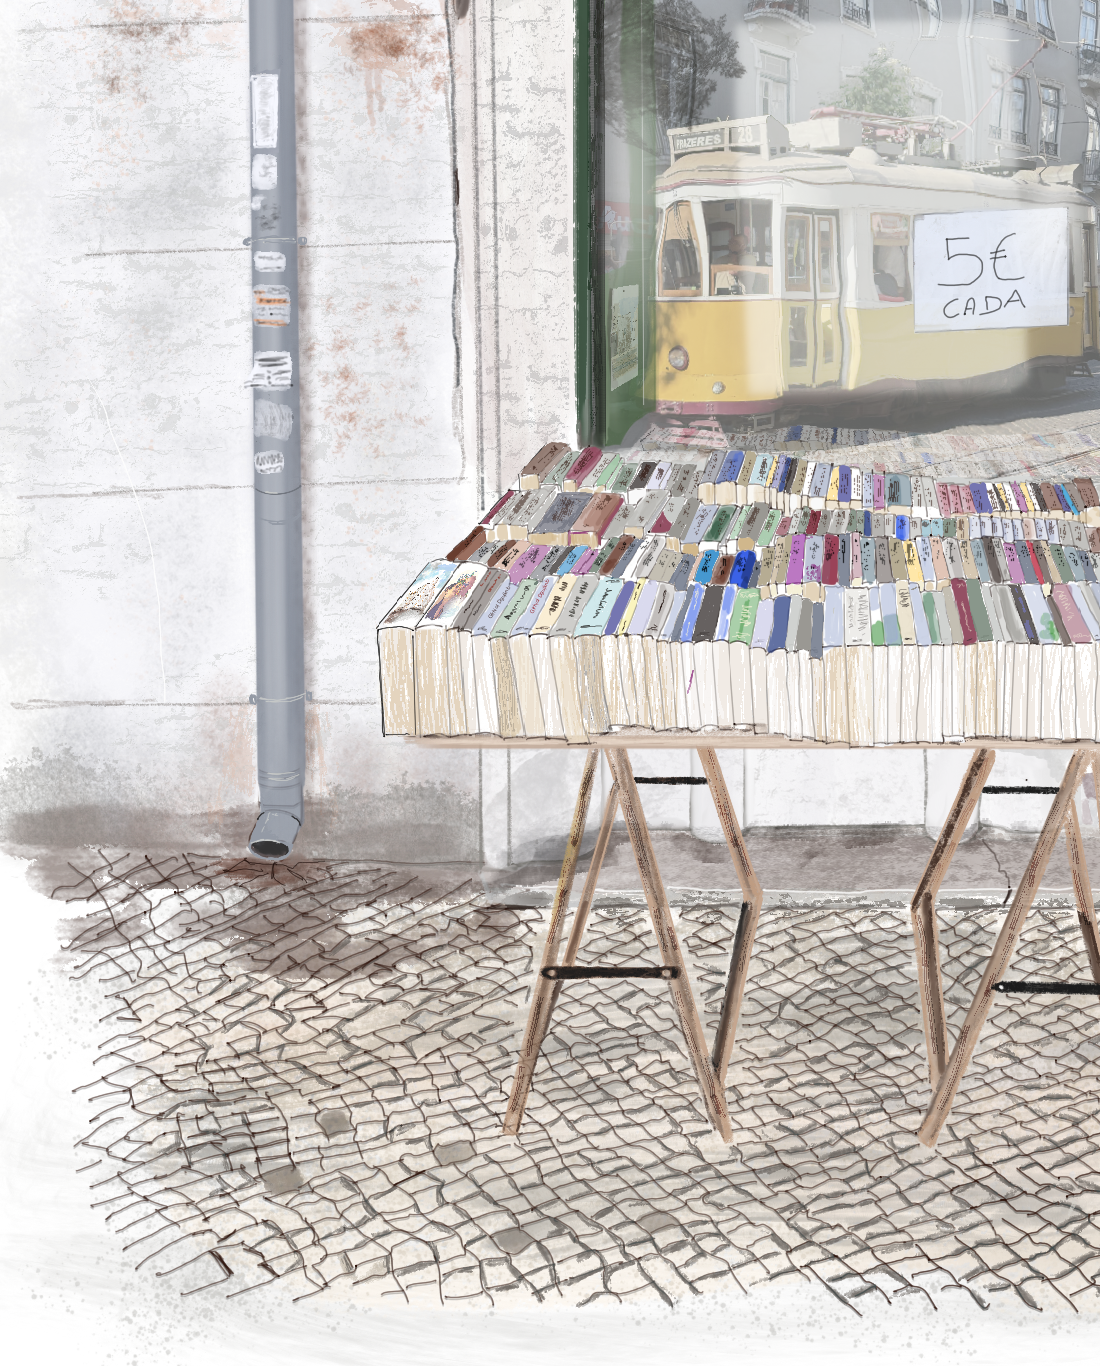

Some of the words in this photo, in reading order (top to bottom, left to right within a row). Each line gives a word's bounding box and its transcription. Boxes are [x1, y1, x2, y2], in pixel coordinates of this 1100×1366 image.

[676, 134, 722, 150] PRAZERES
[737, 125, 753, 143] 28
[937, 232, 1025, 286] 5€
[943, 289, 1026, 318] CADA
